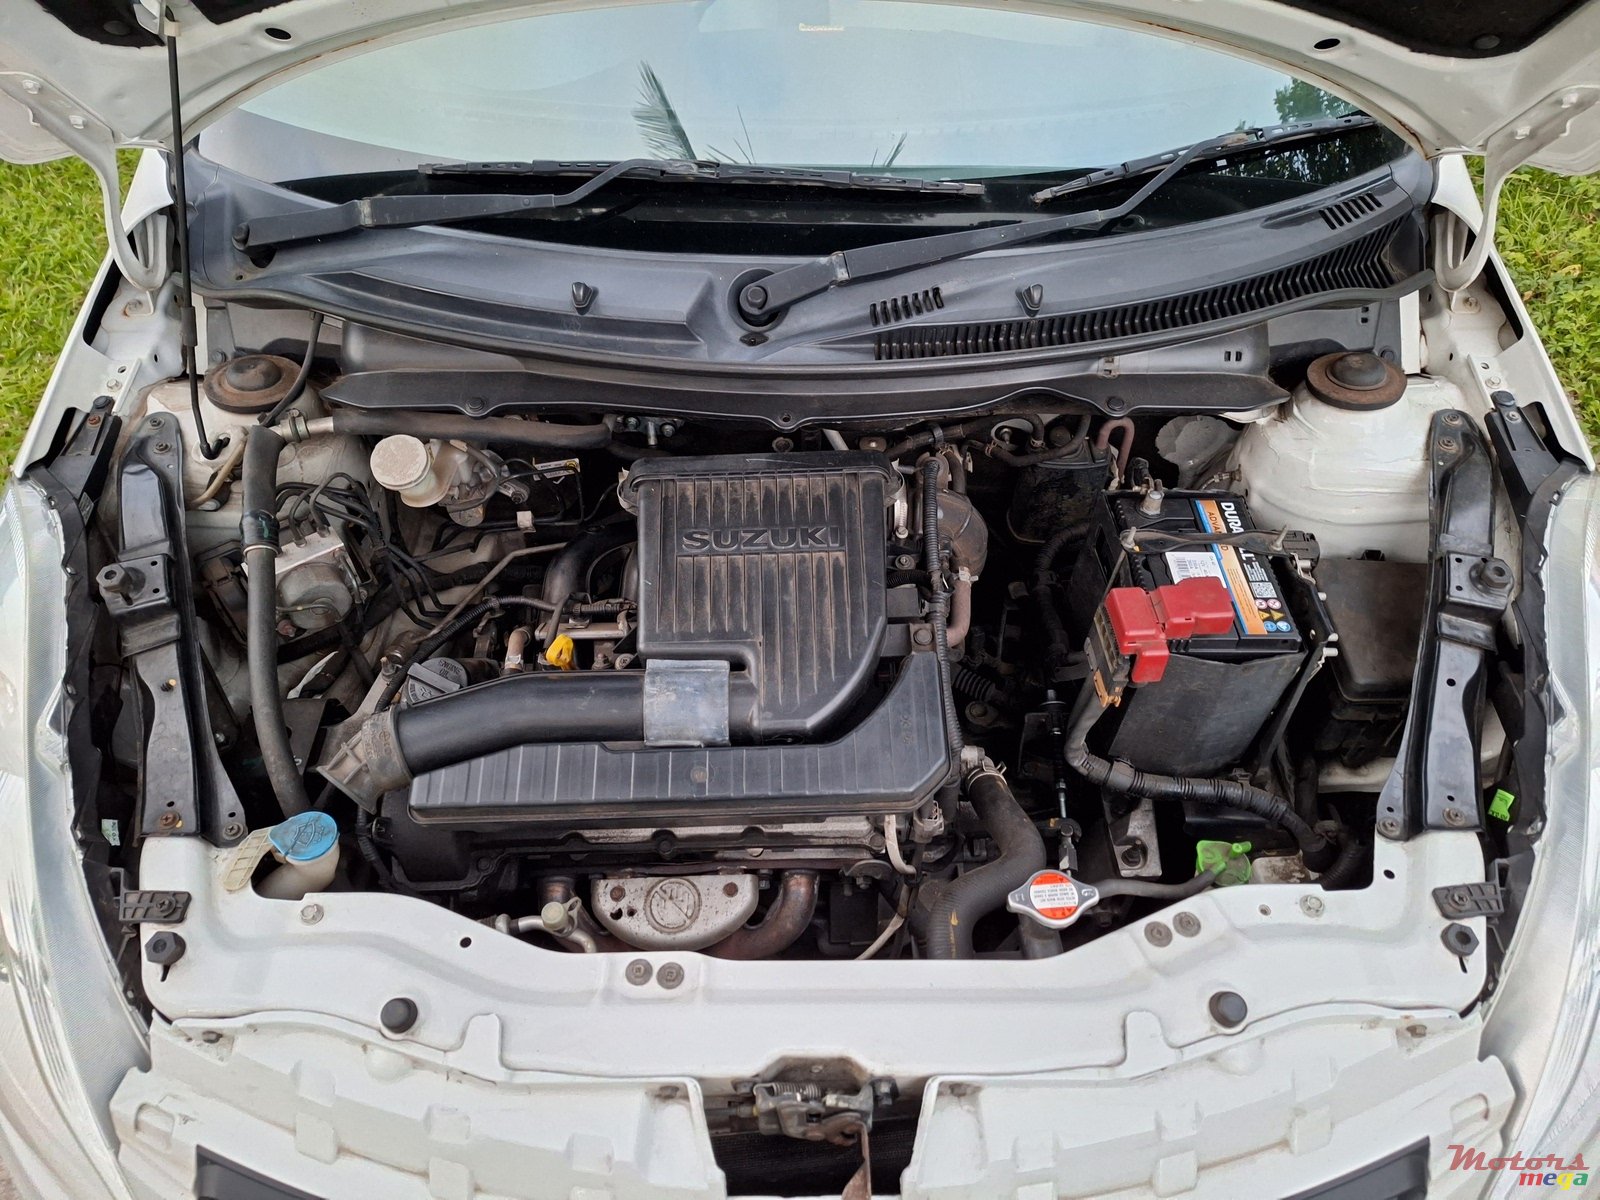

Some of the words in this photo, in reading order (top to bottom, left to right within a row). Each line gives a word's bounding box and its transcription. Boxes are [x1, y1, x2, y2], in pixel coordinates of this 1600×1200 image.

[682, 527, 840, 551] SUZUKI
[1207, 511, 1229, 551] ADVAD
[1220, 502, 1255, 560] DURALL
